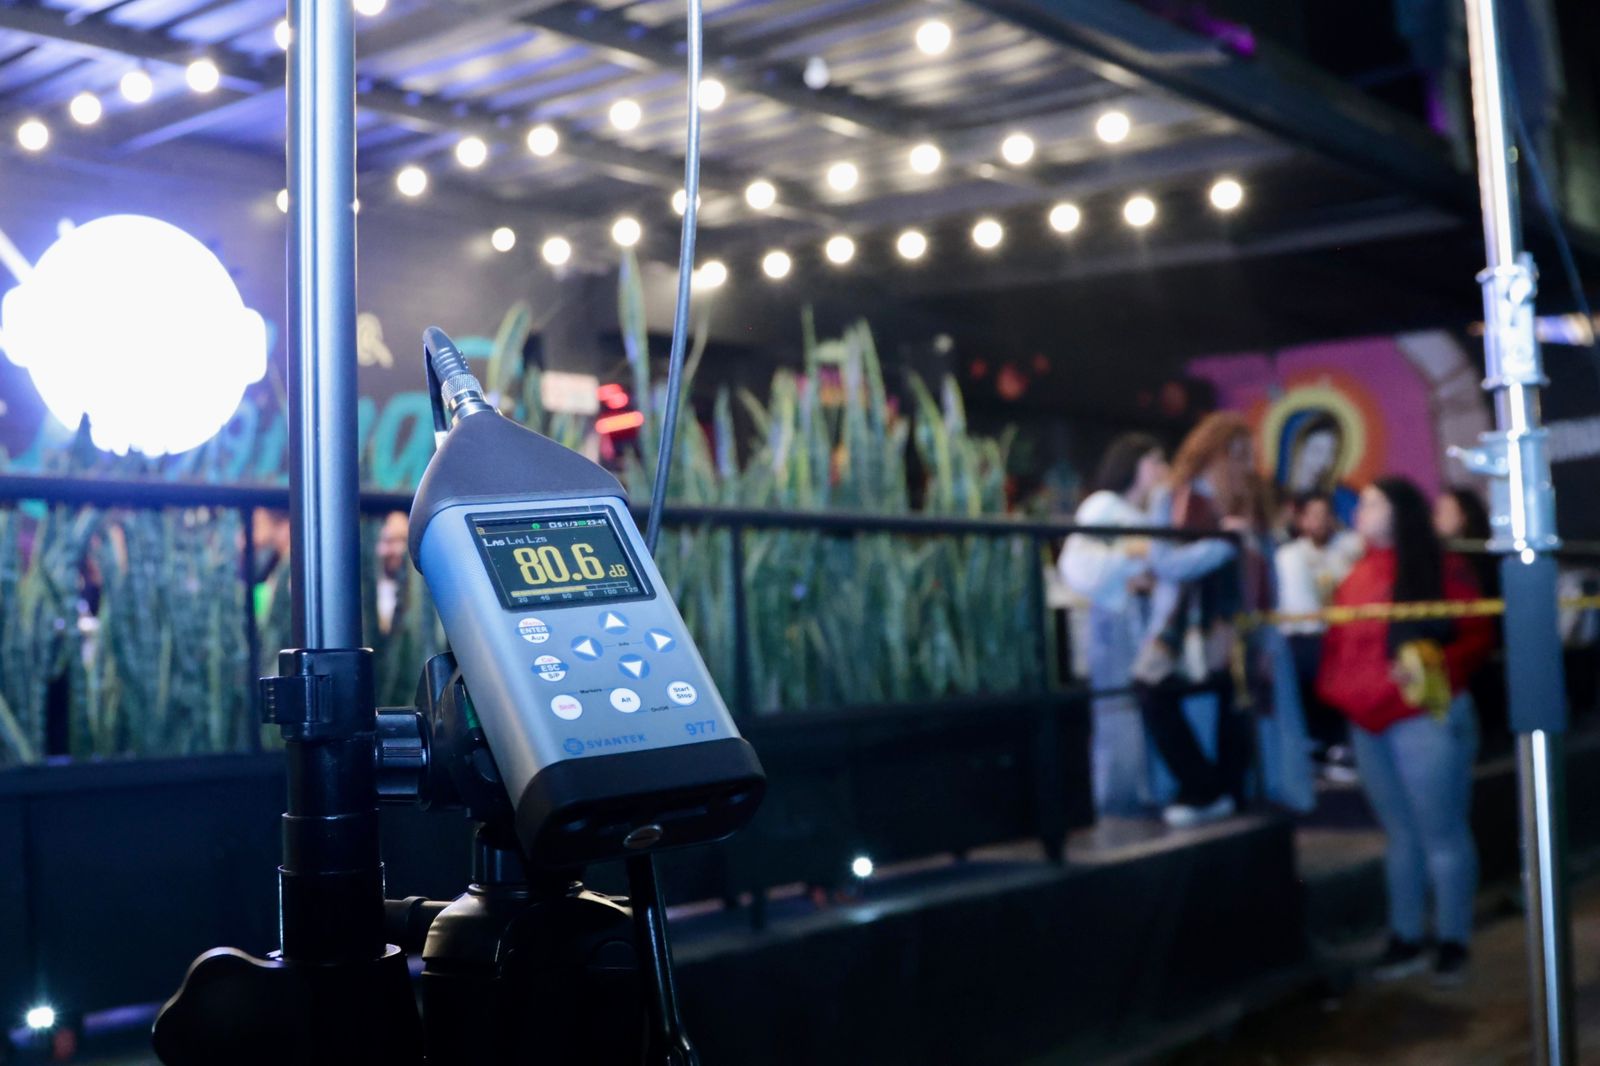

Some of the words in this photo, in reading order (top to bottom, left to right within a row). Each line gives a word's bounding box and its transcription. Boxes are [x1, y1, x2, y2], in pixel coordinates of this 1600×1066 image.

[513, 543, 606, 585] 80.6
[608, 563, 628, 578] dB
[603, 588, 618, 596] 100
[519, 626, 548, 635] ENTER
[541, 664, 561, 672] ESC
[558, 703, 577, 711] Shift
[685, 719, 717, 736] 977
[586, 734, 647, 749] SVANTEK
